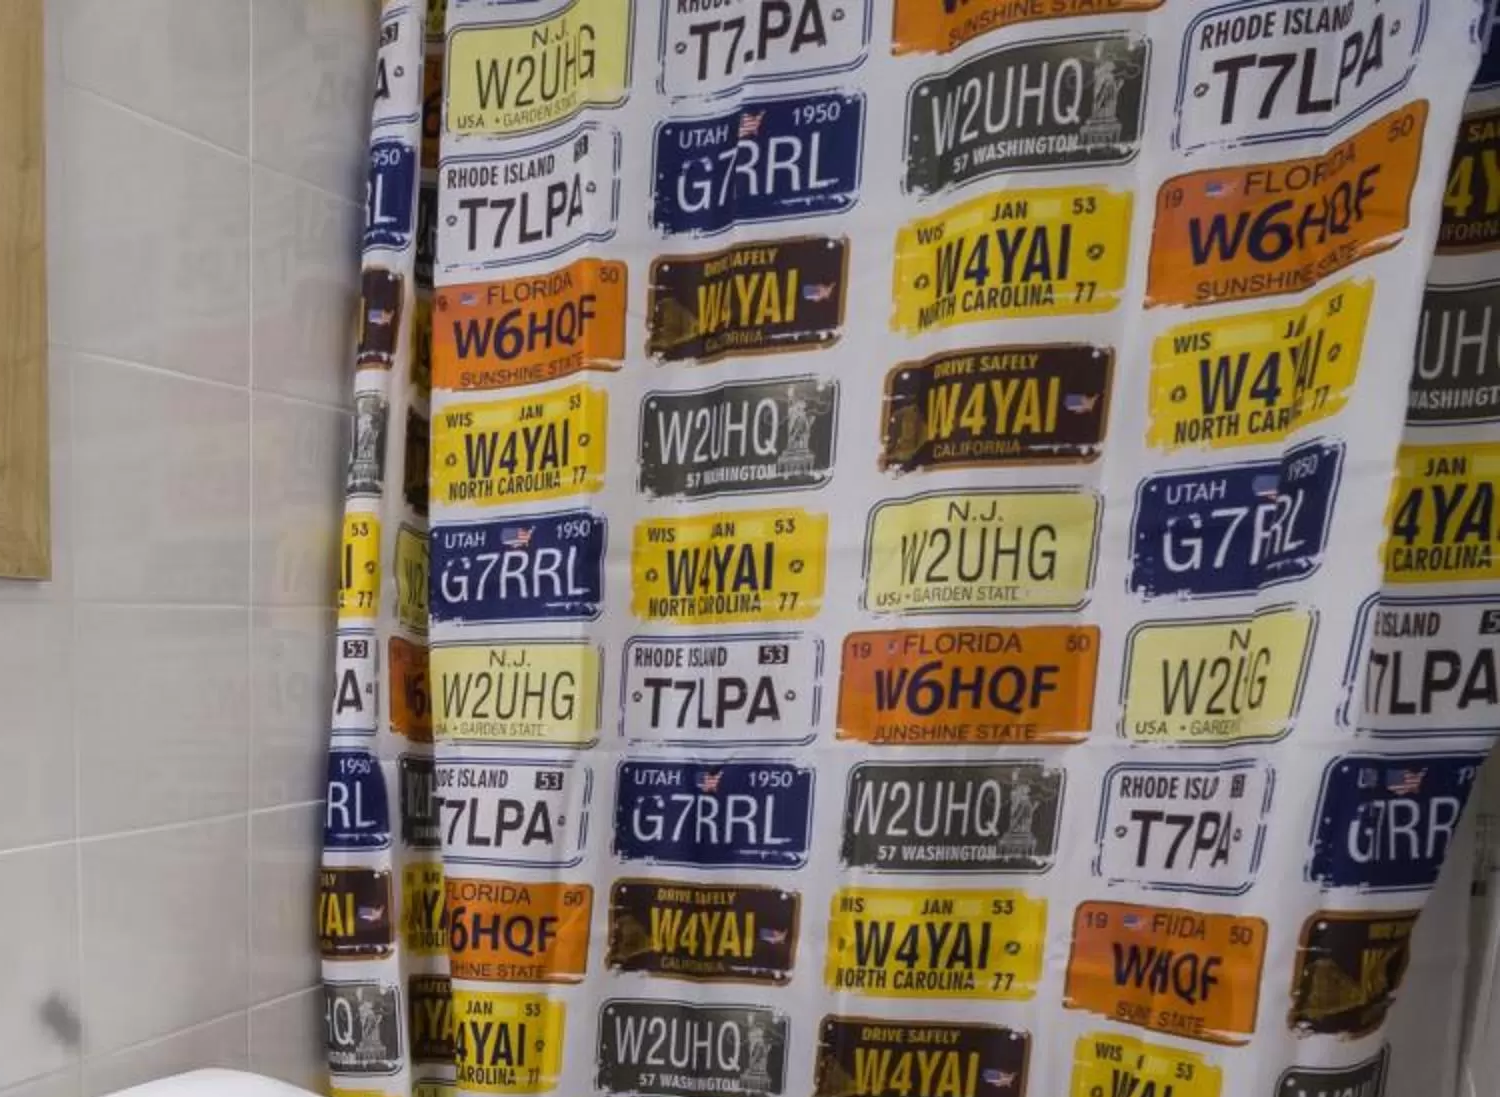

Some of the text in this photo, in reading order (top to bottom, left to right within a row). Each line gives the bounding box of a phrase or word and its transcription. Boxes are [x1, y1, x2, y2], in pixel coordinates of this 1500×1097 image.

[532, 22, 569, 49] N.J.
[949, 0, 1046, 45] SUNSHINE
[1201, 11, 1275, 50] RHODE
[475, 25, 596, 111] W2UHG
[1213, 14, 1385, 125] T7LPA
[457, 103, 552, 129] USA GARDEN
[931, 58, 1082, 158] W2UHQ
[679, 103, 841, 149] UTAH 1950
[953, 134, 1080, 174] 57 WASHINGTON
[1164, 115, 1414, 210] 19 50
[447, 155, 556, 189] RHODE ISLAND
[677, 132, 840, 213] G7RRL
[458, 173, 584, 251] T7LPA
[916, 197, 1097, 245] WIS JAN 53
[1189, 165, 1381, 266] W6HQF
[936, 223, 1073, 299] W4YAI
[486, 270, 618, 305] FLORIDA 50
[1196, 262, 1314, 301] SUNSHINE
[962, 282, 1098, 315] CAROLINA 77
[453, 294, 597, 361] W6HQF
[1173, 331, 1213, 354] WIS
[460, 351, 584, 387] SUNSHINE STATE
[934, 353, 1040, 379] DRIVE SAFELY
[445, 404, 544, 428] WIS JAN
[927, 376, 1061, 442] W4YAI
[657, 397, 779, 465] W2UHQ
[1173, 415, 1239, 445] NORTH
[463, 419, 570, 480] W4YAI
[933, 441, 1023, 460] CALIFORNIA
[448, 465, 587, 502] NORTH CAROLINA 77
[1424, 458, 1467, 481] JAN
[1164, 480, 1227, 506] UTAH
[947, 500, 1004, 522] N.J.
[351, 521, 370, 538] 53
[444, 522, 589, 551] UTAH 1950
[647, 518, 796, 543] WIS 53
[666, 540, 775, 597] W4YAI
[900, 524, 1058, 587] W2UHG
[1391, 546, 1493, 575] CAROLINA
[440, 545, 591, 604] G7RRL
[357, 592, 373, 609] 77
[778, 592, 800, 611] 77
[911, 585, 1020, 604] GARDEN STATE
[488, 650, 531, 669] N.J.
[635, 651, 684, 670] RHODE
[851, 632, 1091, 660] 19 FLORIDA 50
[442, 671, 576, 721] W2UHG
[643, 676, 781, 730] T7LPA
[873, 662, 1061, 717] W6HQF
[459, 722, 544, 738] GARDEN STATE
[976, 724, 1037, 741] STATE
[1136, 720, 1168, 736] USA
[340, 759, 372, 776] 1950
[457, 767, 509, 789] ISLAND
[634, 769, 793, 788] UTAH 1950
[1119, 774, 1178, 800] RHODE
[632, 794, 793, 846] G7RRL
[877, 845, 999, 862] 57 WASHINGTON
[563, 890, 583, 906] 50
[920, 899, 1014, 917] JAN 53
[648, 907, 757, 959] W4YAI
[1086, 911, 1108, 931] 19
[1229, 923, 1253, 946] 50
[853, 920, 992, 972] W4YAI
[496, 963, 547, 980] STATE
[835, 969, 1015, 992] NORTH CAROLINA 77
[465, 1001, 541, 1017] JAN 53
[1157, 1007, 1204, 1033] STATE
[615, 1015, 741, 1072] W2UHQ
[861, 1026, 960, 1046] DRIVE SAFELY
[1095, 1042, 1194, 1081] WIS 53
[639, 1073, 740, 1092] 57 WASHINGTON
